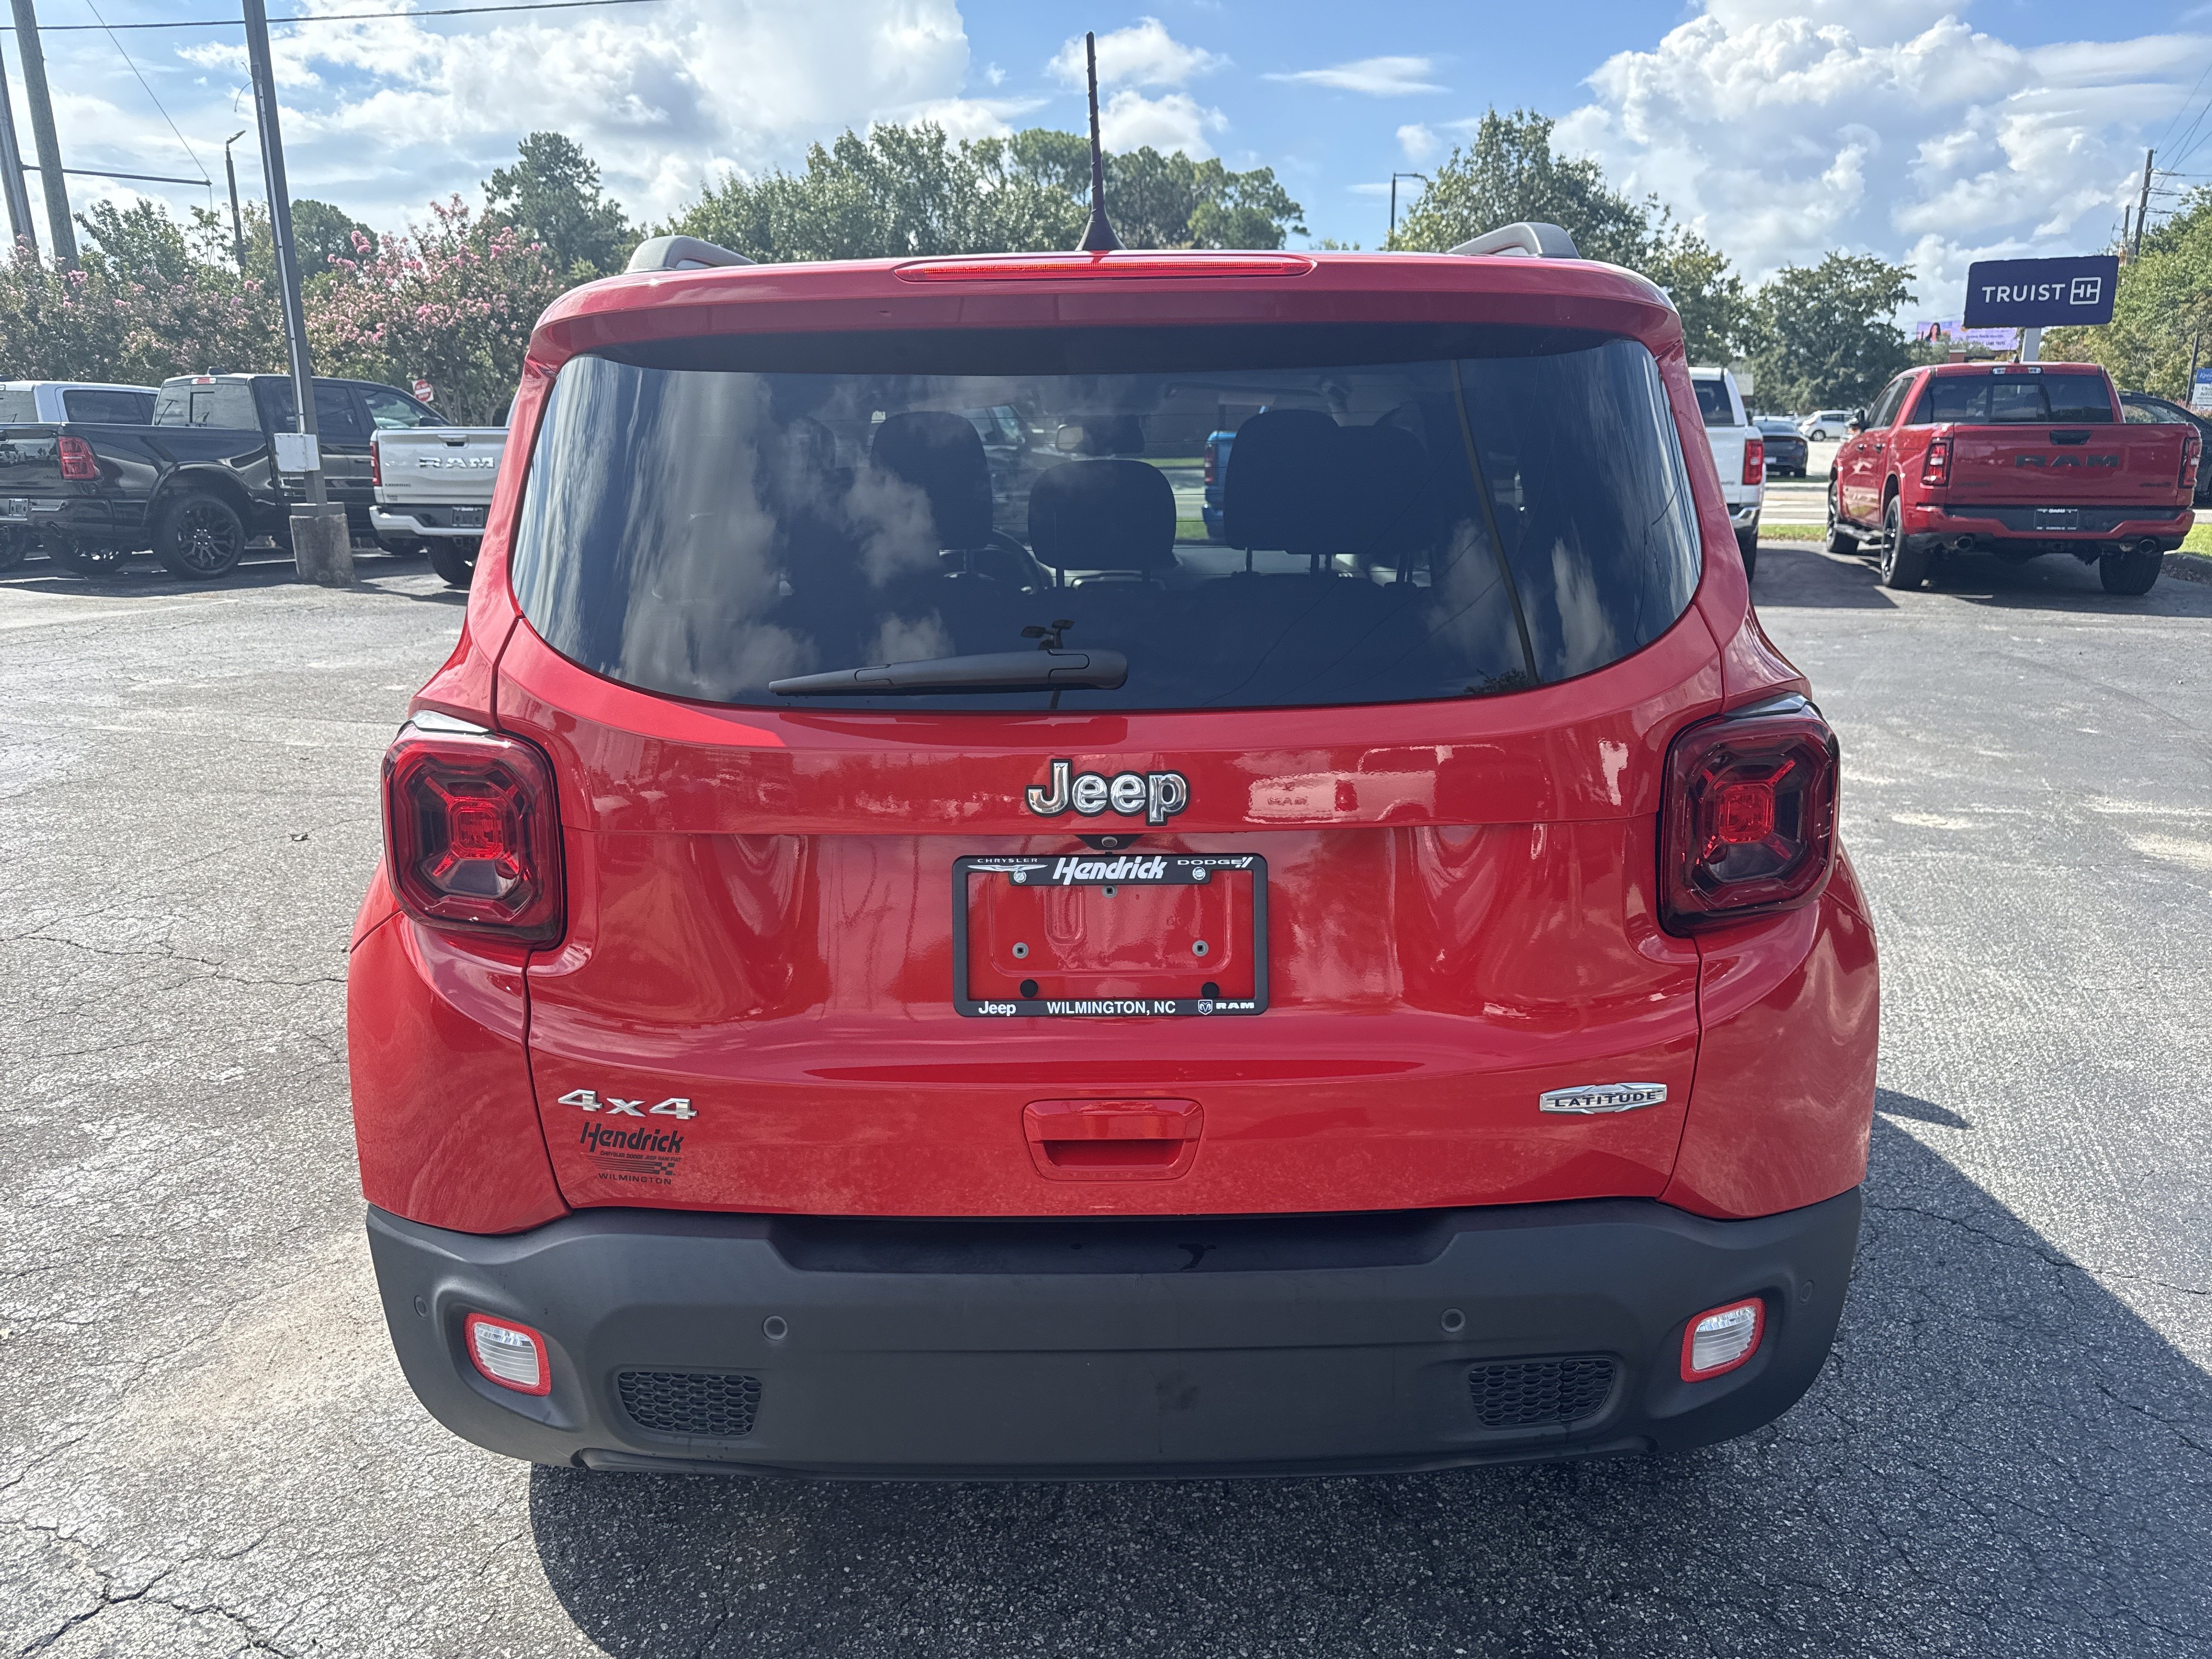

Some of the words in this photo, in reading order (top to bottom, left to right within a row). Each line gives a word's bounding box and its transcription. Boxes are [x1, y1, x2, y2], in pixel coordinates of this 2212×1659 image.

[1982, 284, 2066, 303] TRUIST
[419, 457, 494, 468] RAM
[2015, 455, 2120, 467] RAM
[1026, 760, 1188, 824] Jeep
[1052, 856, 1167, 885] Hendrick
[978, 1001, 1017, 1017] Jeep
[1046, 1001, 1150, 1016] WILMINGTON,
[1154, 1001, 1176, 1014] NC
[1554, 1092, 1656, 1107] LATITUDE
[579, 1121, 684, 1153] Hendrick
[598, 1172, 672, 1185] WILMINGTON
